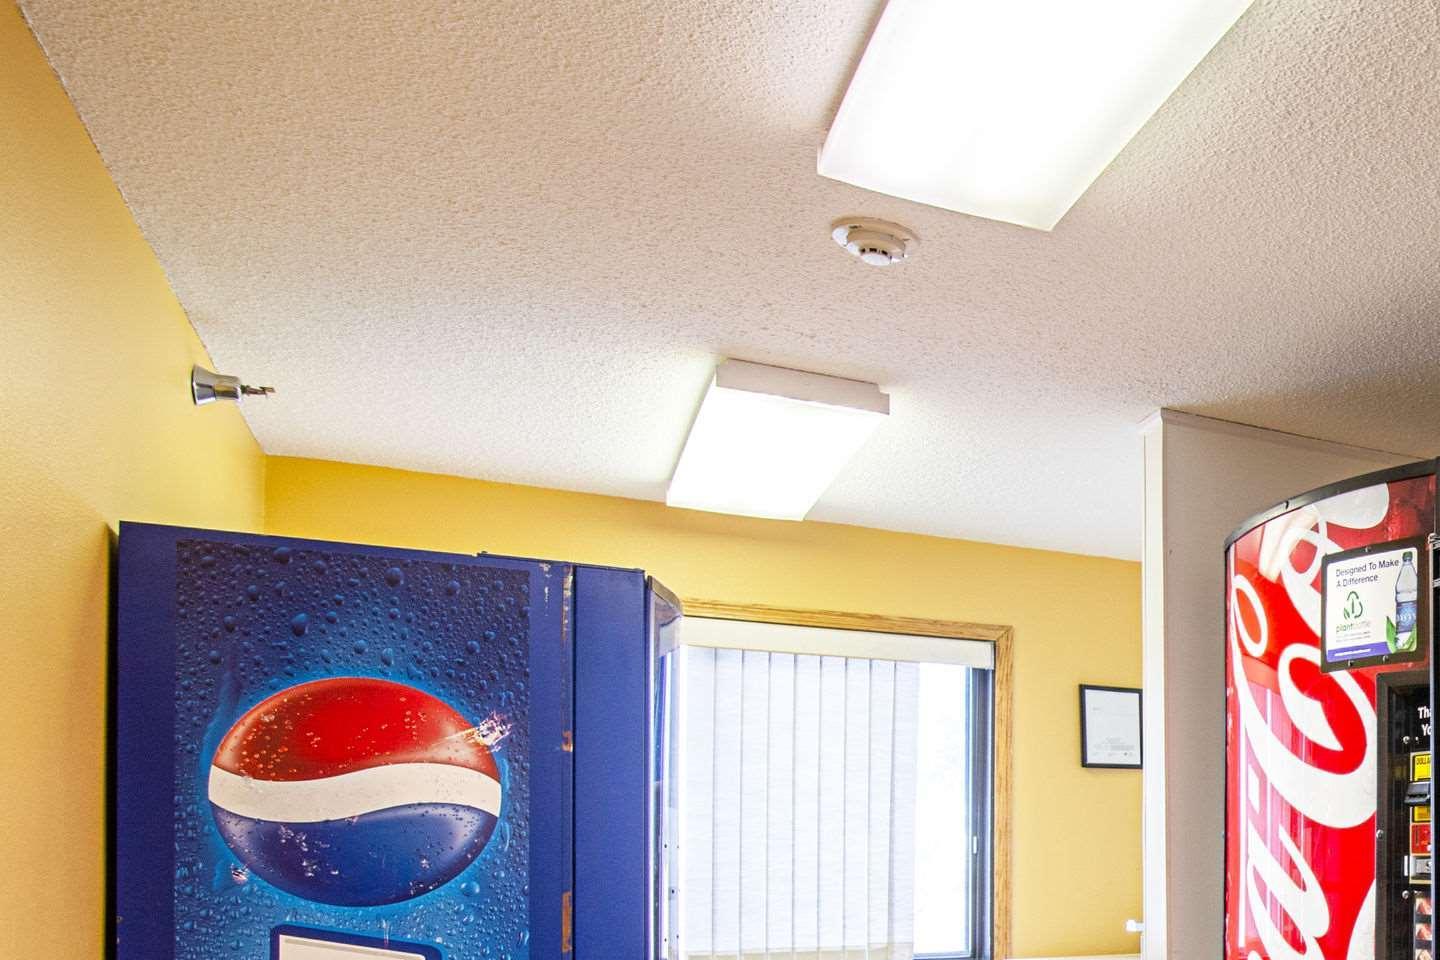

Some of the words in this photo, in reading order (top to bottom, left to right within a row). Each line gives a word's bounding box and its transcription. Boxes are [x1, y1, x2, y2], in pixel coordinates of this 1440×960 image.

[1336, 564, 1367, 577] Designed
[1369, 562, 1377, 570] To
[1379, 558, 1400, 568] Make
[1343, 575, 1379, 587] Difference
